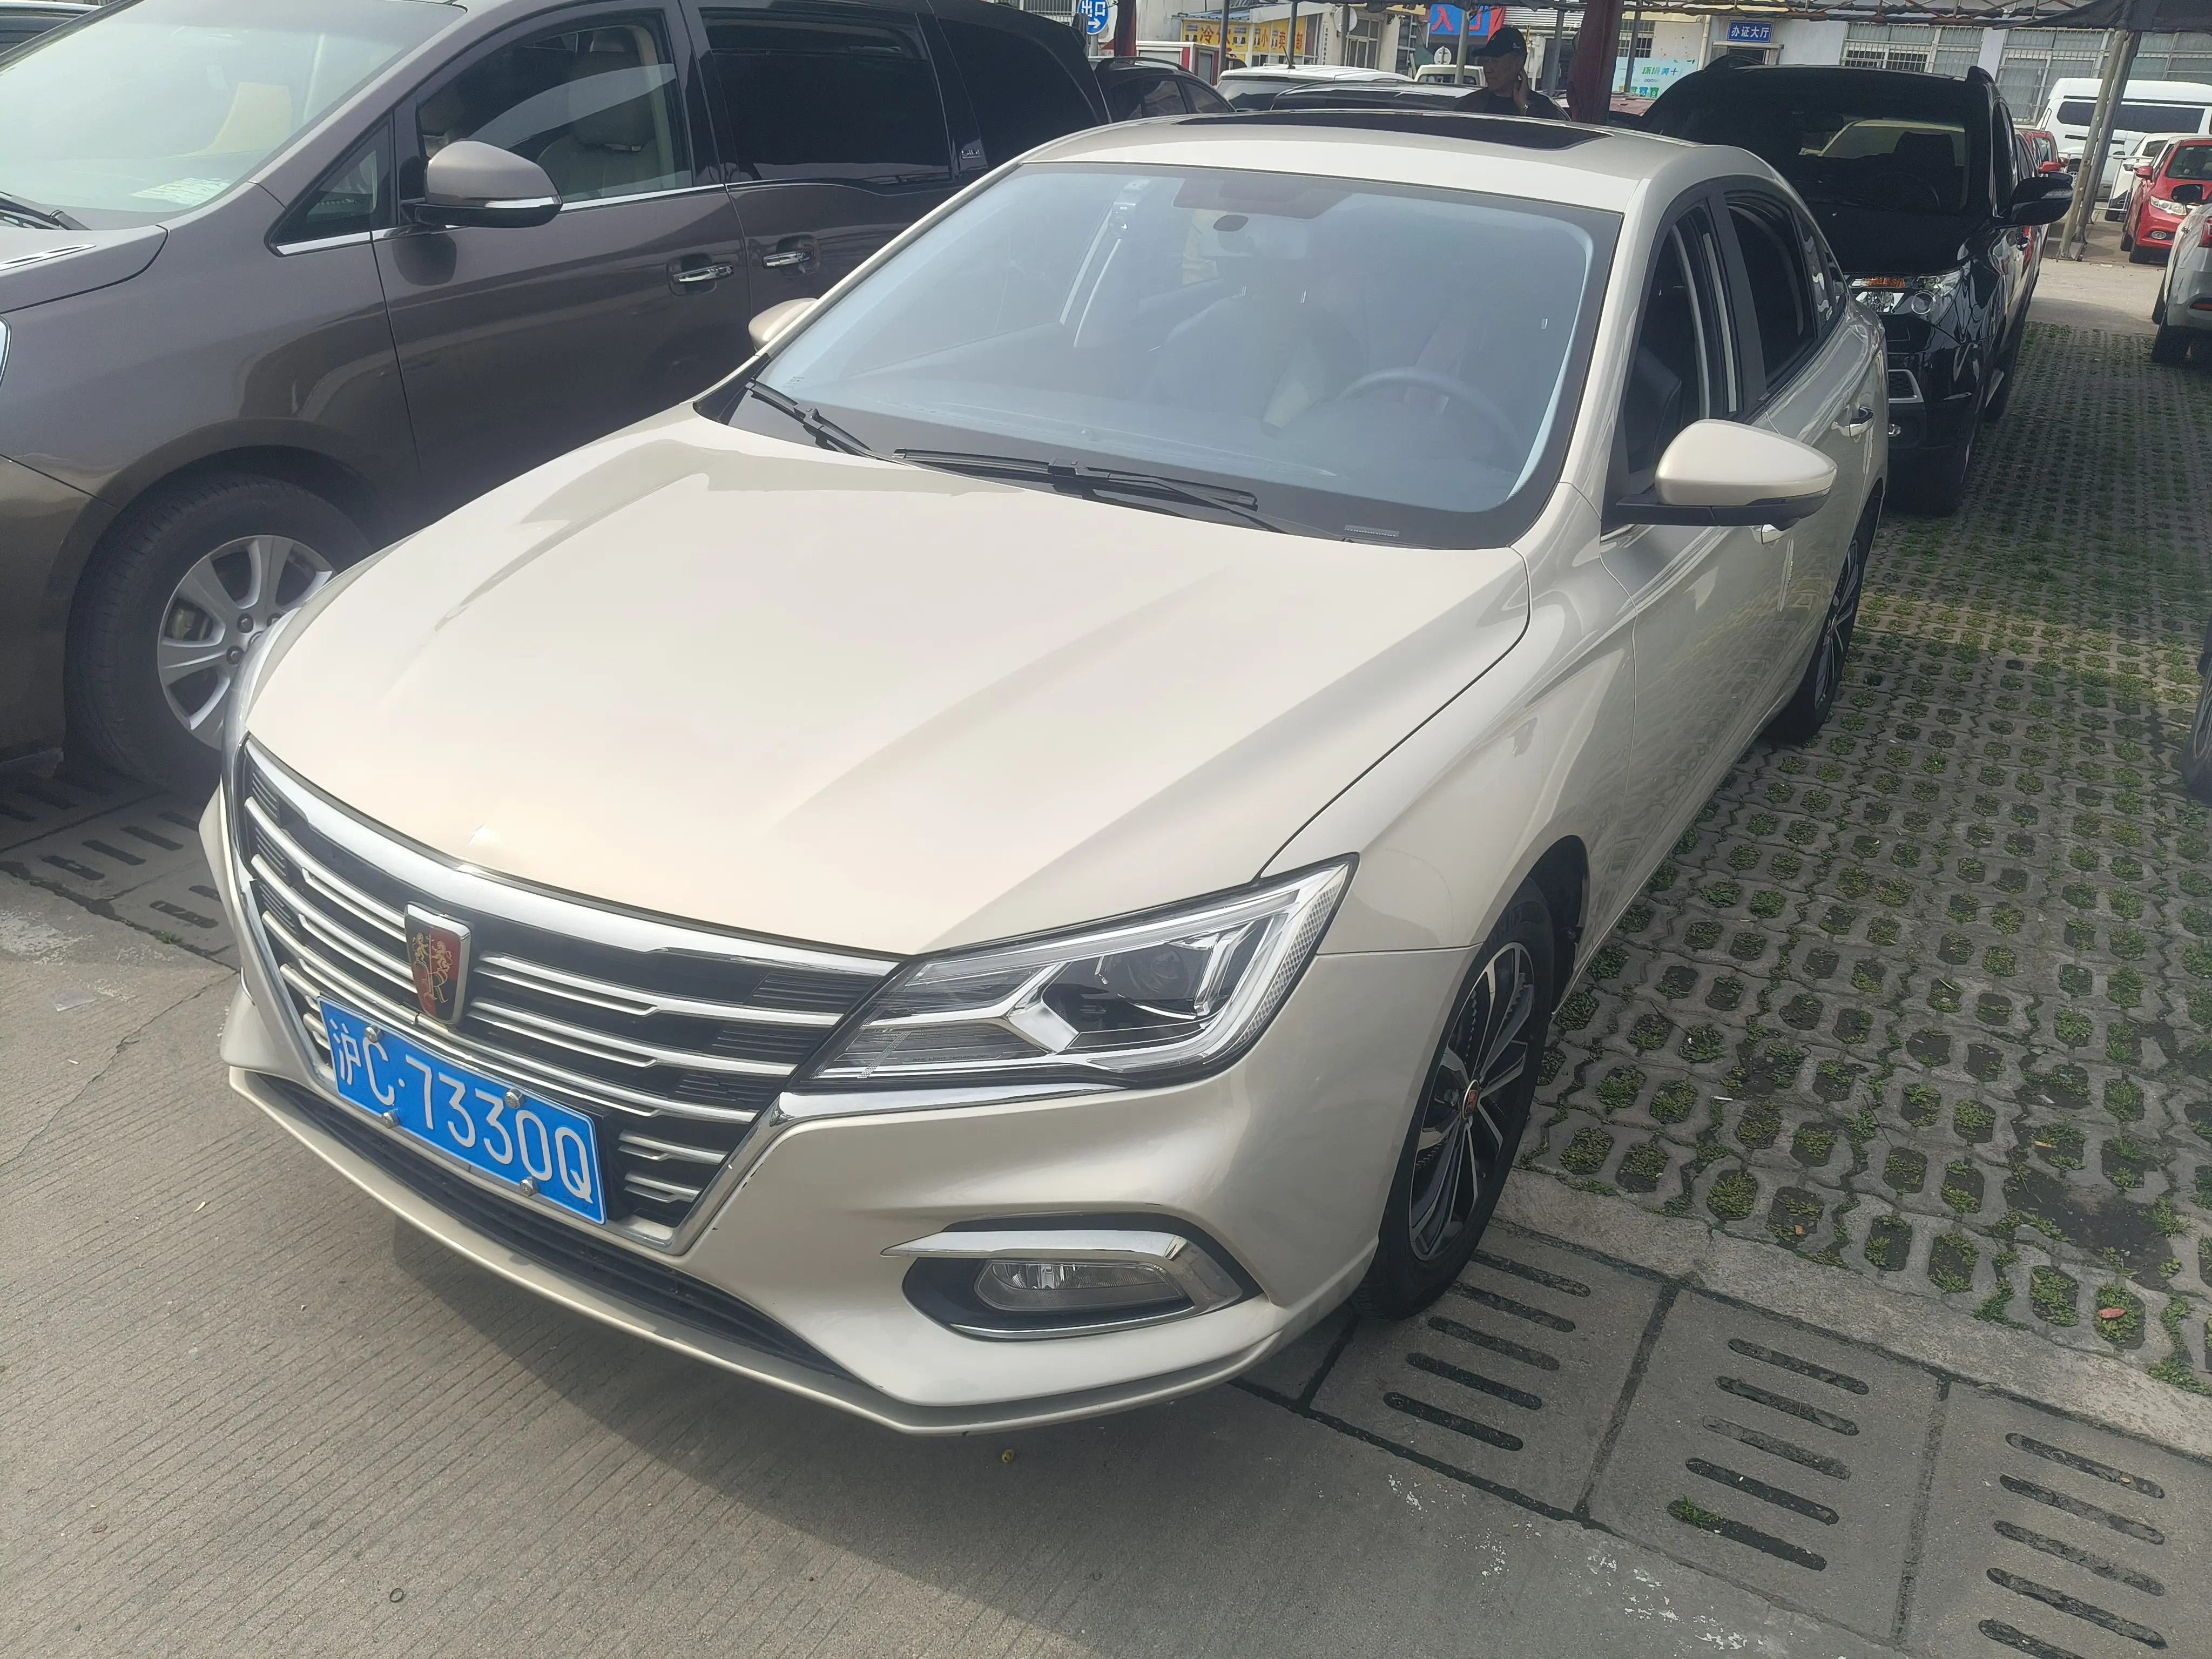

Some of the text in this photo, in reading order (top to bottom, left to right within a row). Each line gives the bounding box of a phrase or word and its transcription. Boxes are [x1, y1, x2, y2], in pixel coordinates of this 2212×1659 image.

[1081, 0, 1105, 17] 出口
[1731, 25, 1770, 38] 办证大厅
